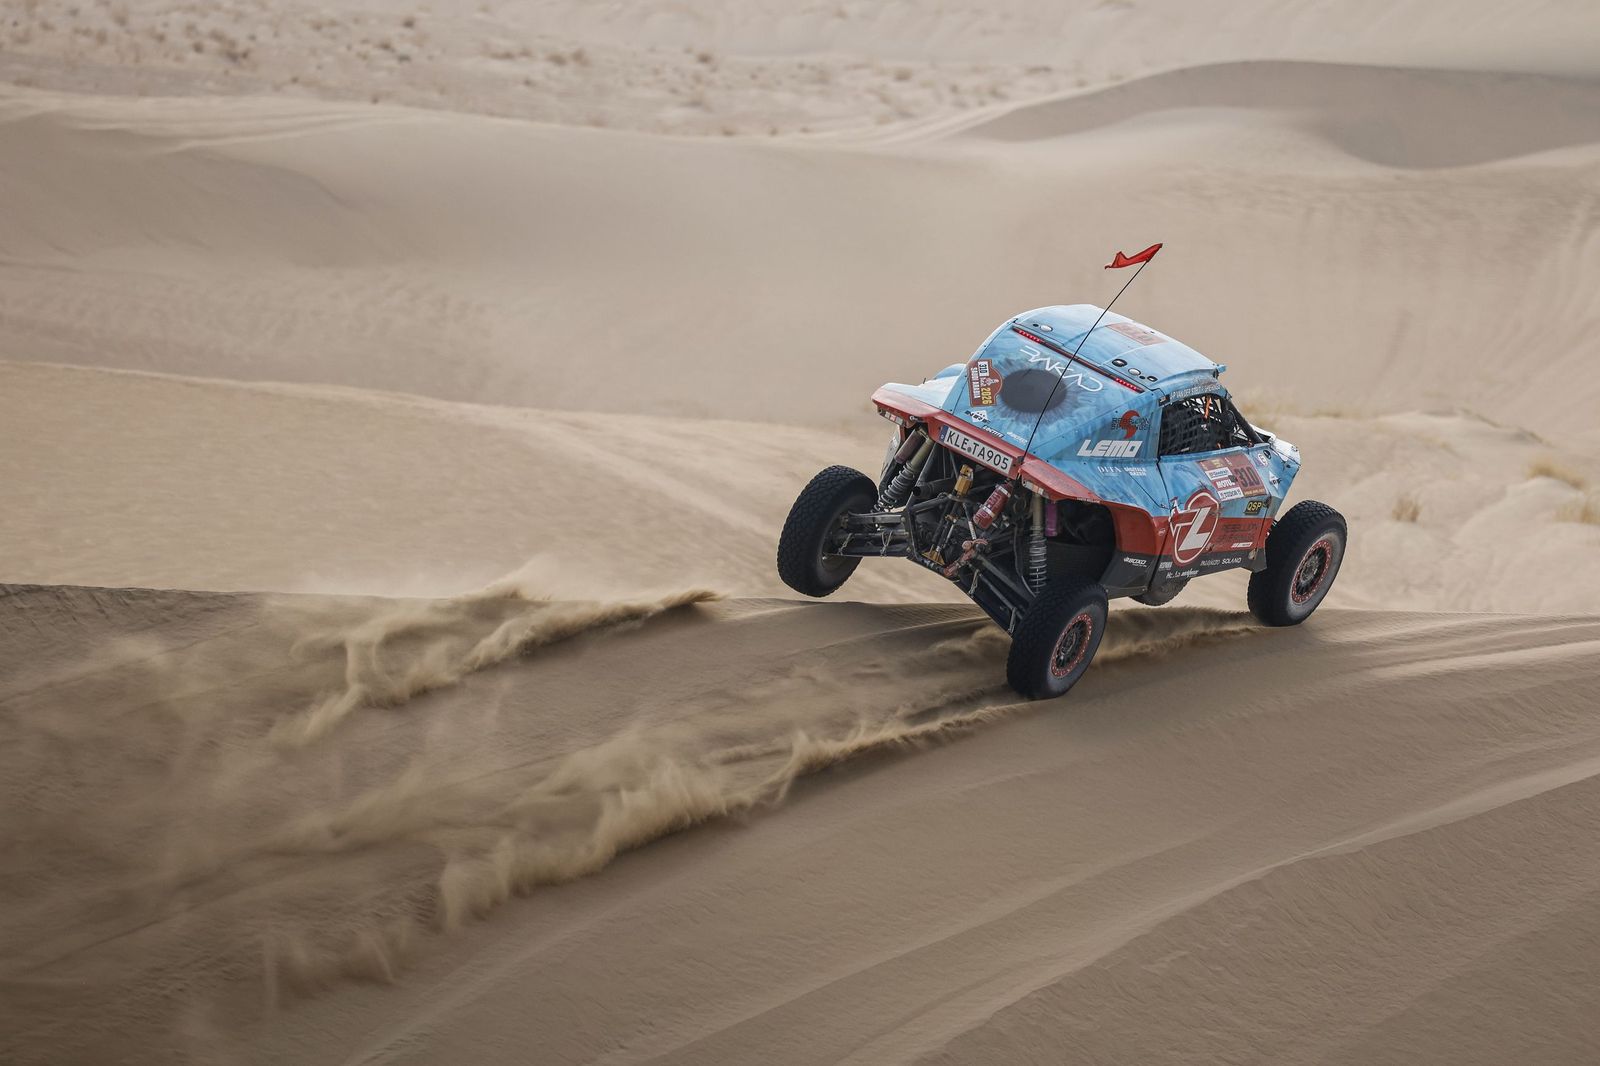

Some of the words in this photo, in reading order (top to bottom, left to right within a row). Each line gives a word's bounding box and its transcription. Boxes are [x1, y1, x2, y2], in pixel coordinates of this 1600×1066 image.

[979, 363, 988, 374] 310
[981, 387, 992, 405] 2026
[1077, 440, 1143, 458] LEMO
[1234, 466, 1260, 488] 310
[1247, 501, 1262, 511] QSP
[1221, 557, 1242, 565] SOLANO
